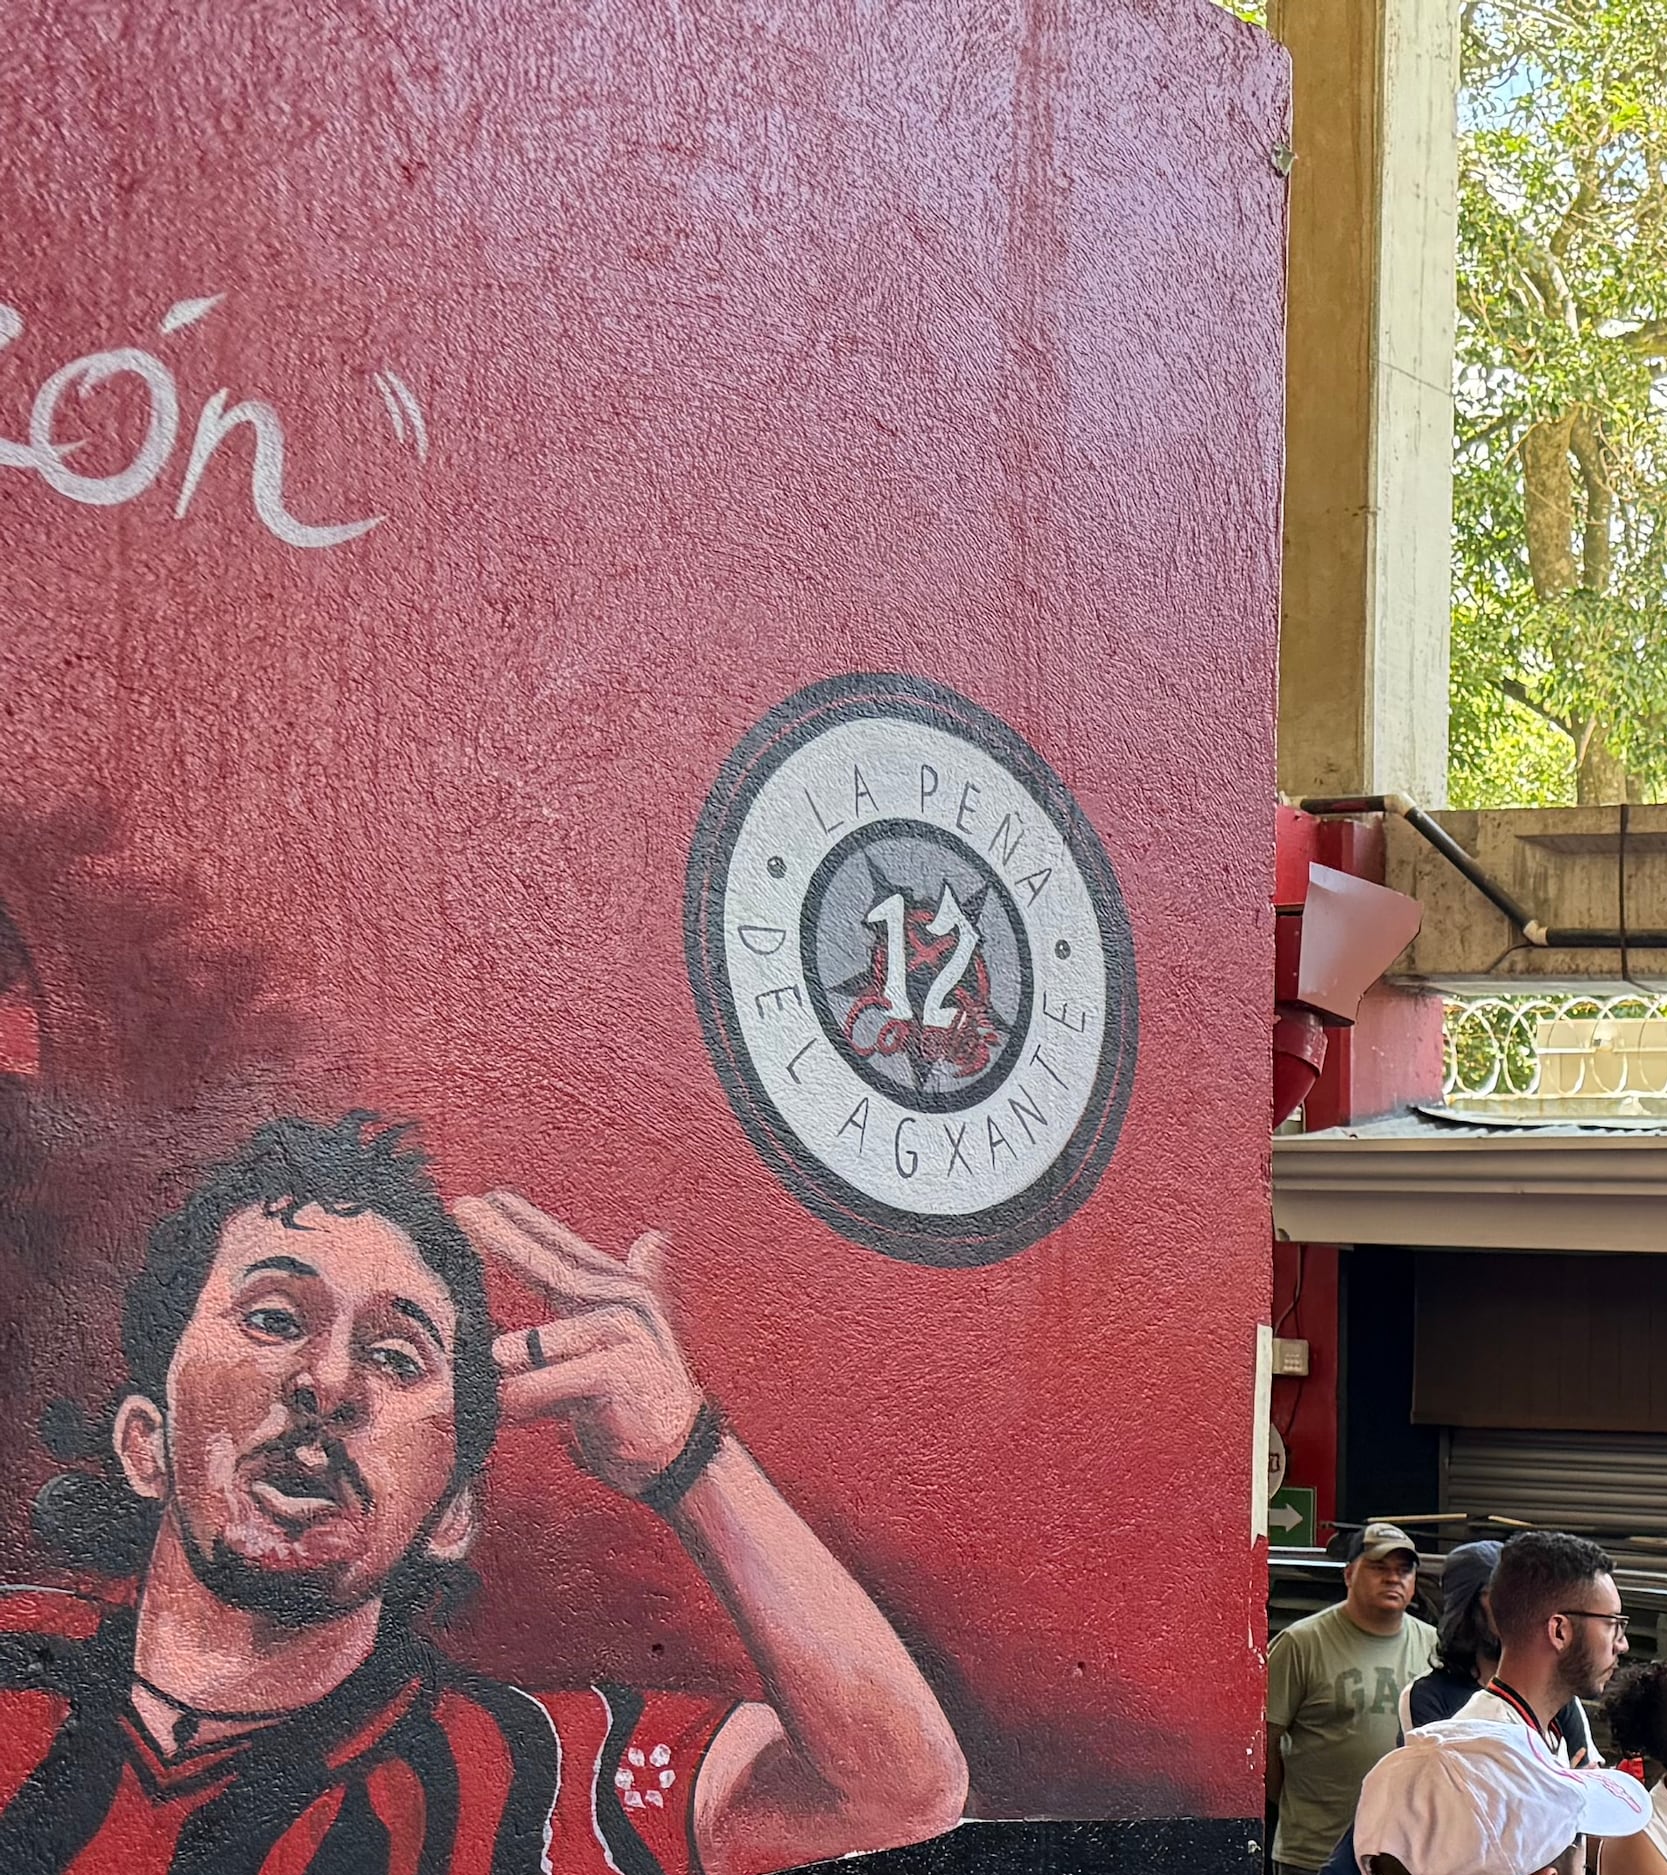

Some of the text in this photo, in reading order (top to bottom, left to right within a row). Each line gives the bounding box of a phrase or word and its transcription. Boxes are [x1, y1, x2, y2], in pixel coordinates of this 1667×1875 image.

[803, 763, 1054, 906] LA PEÑA
[862, 882, 980, 1028] 12
